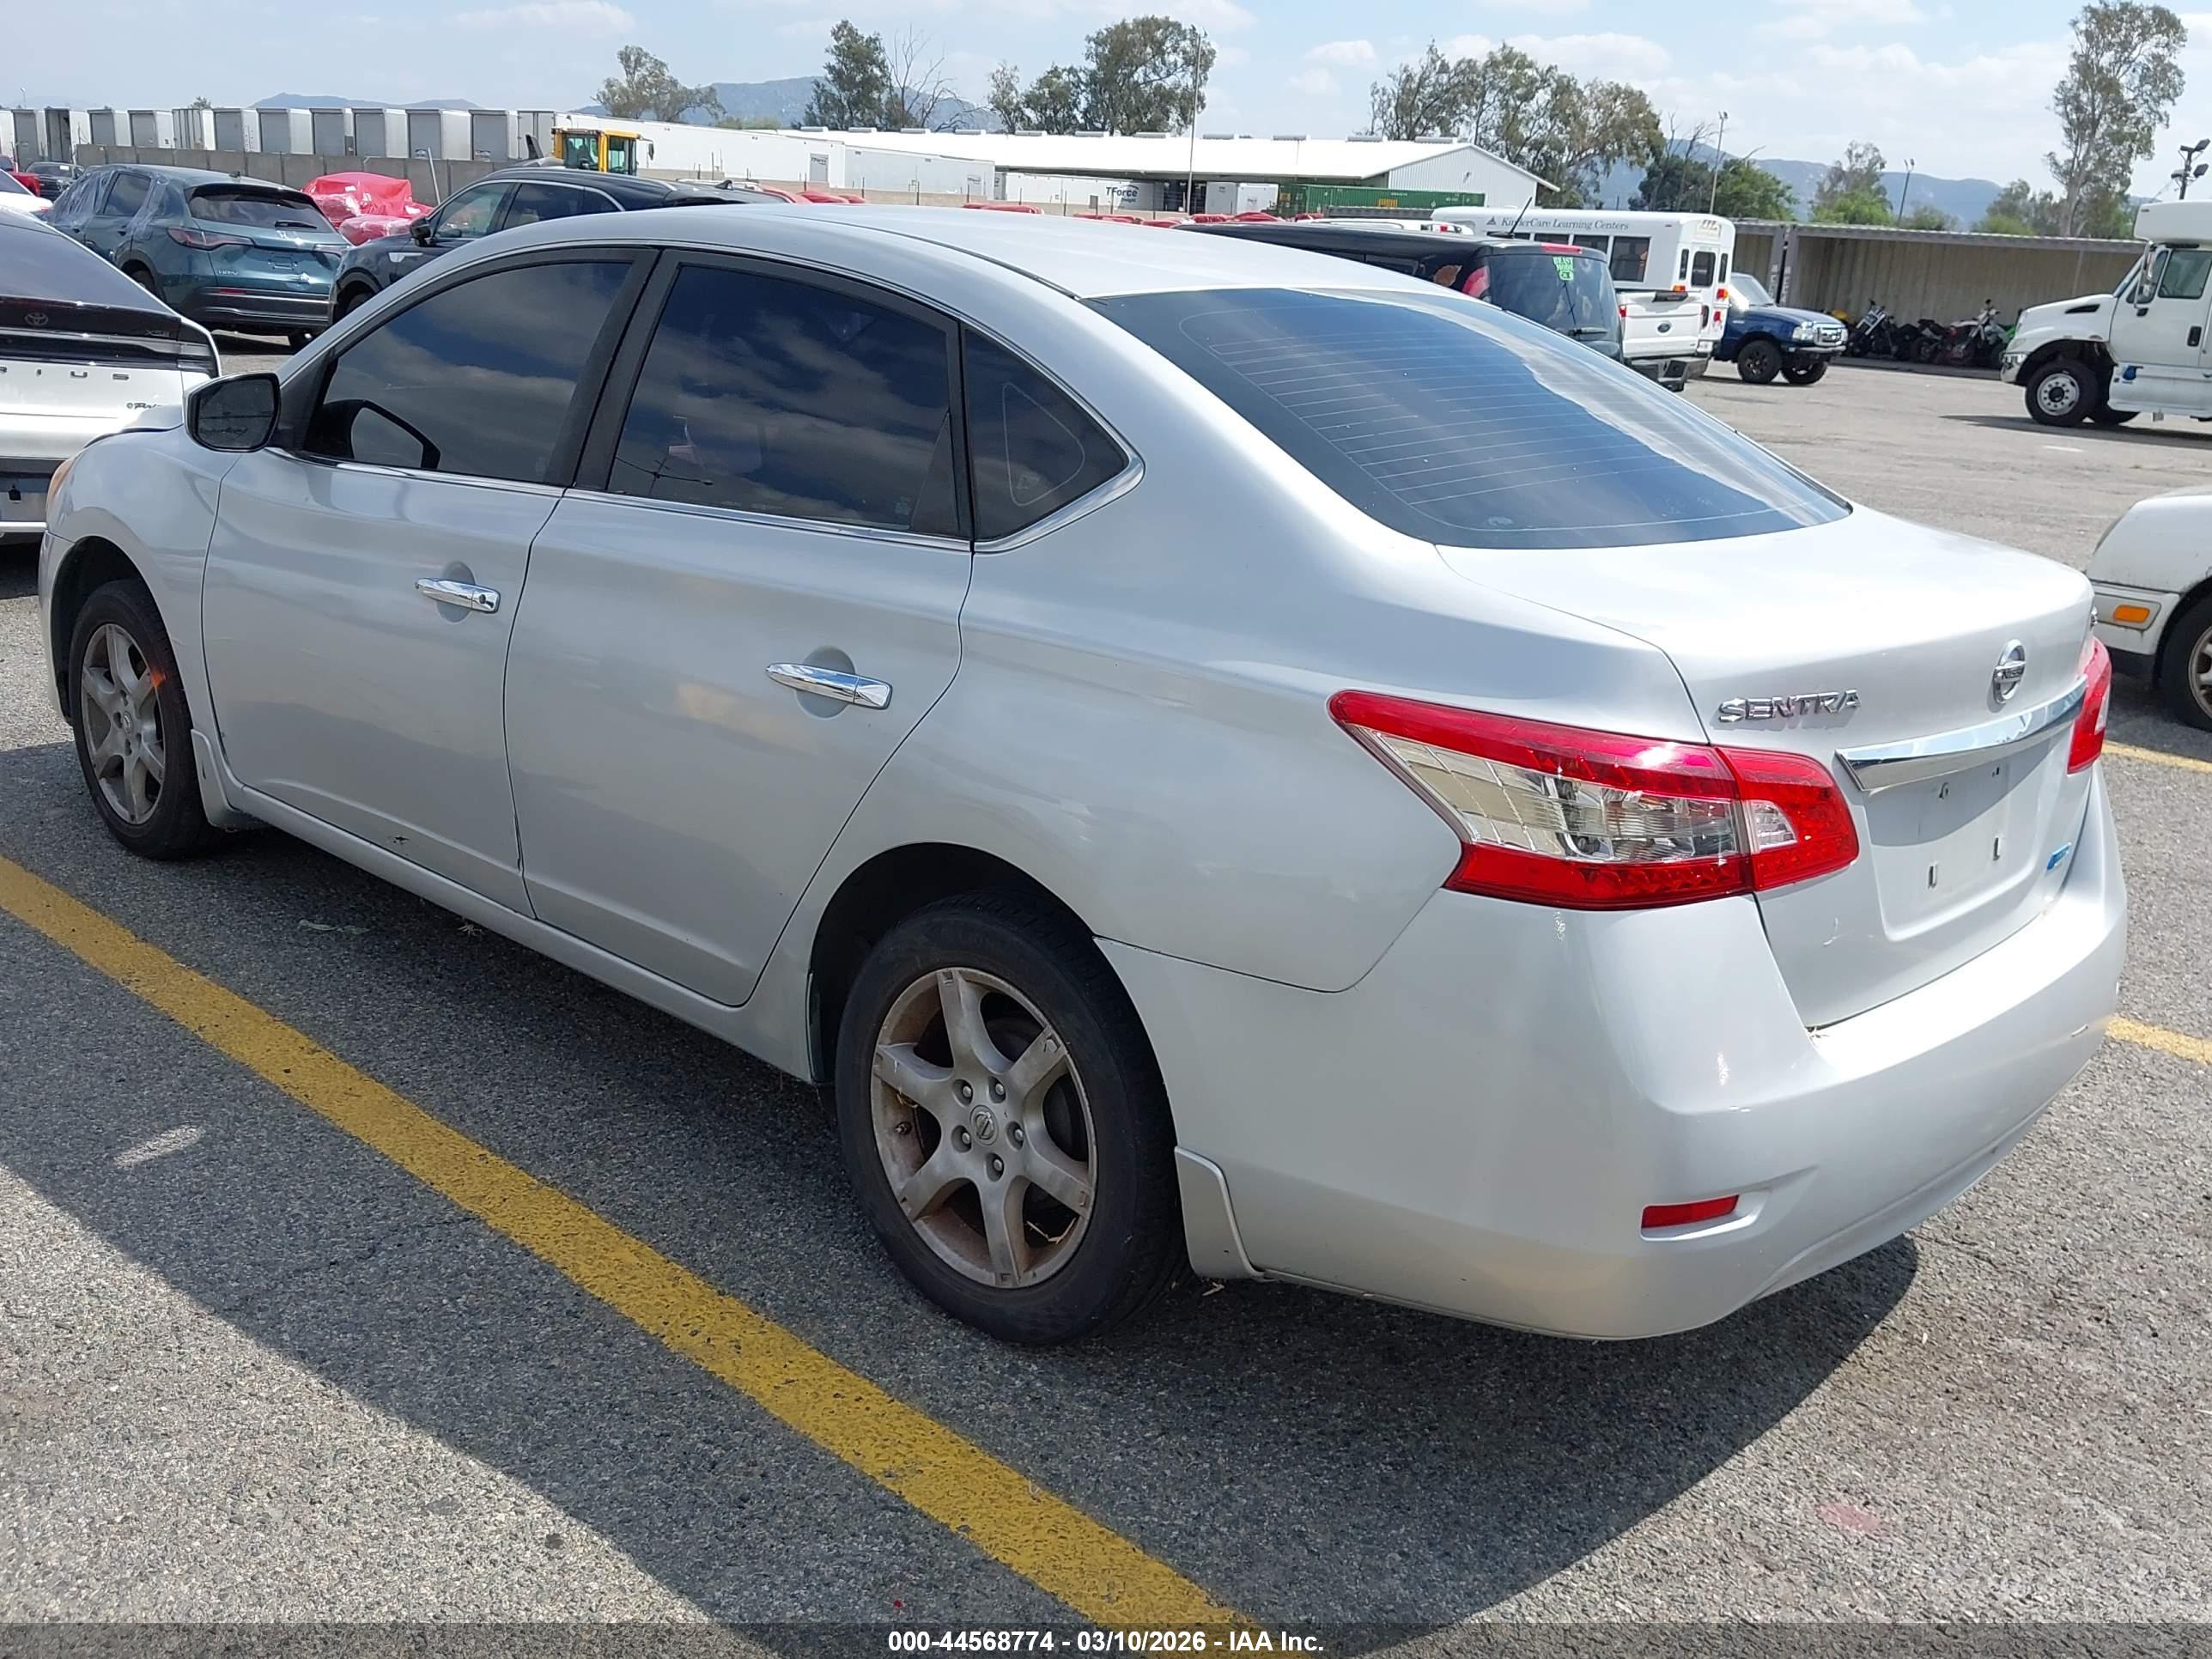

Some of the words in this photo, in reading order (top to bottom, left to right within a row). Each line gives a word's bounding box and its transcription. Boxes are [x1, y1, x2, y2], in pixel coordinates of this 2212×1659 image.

[1106, 186, 1139, 198] TForce
[1553, 219, 1593, 230] Learning
[1595, 220, 1629, 230] Centers
[1718, 690, 1861, 723] SENTRA
